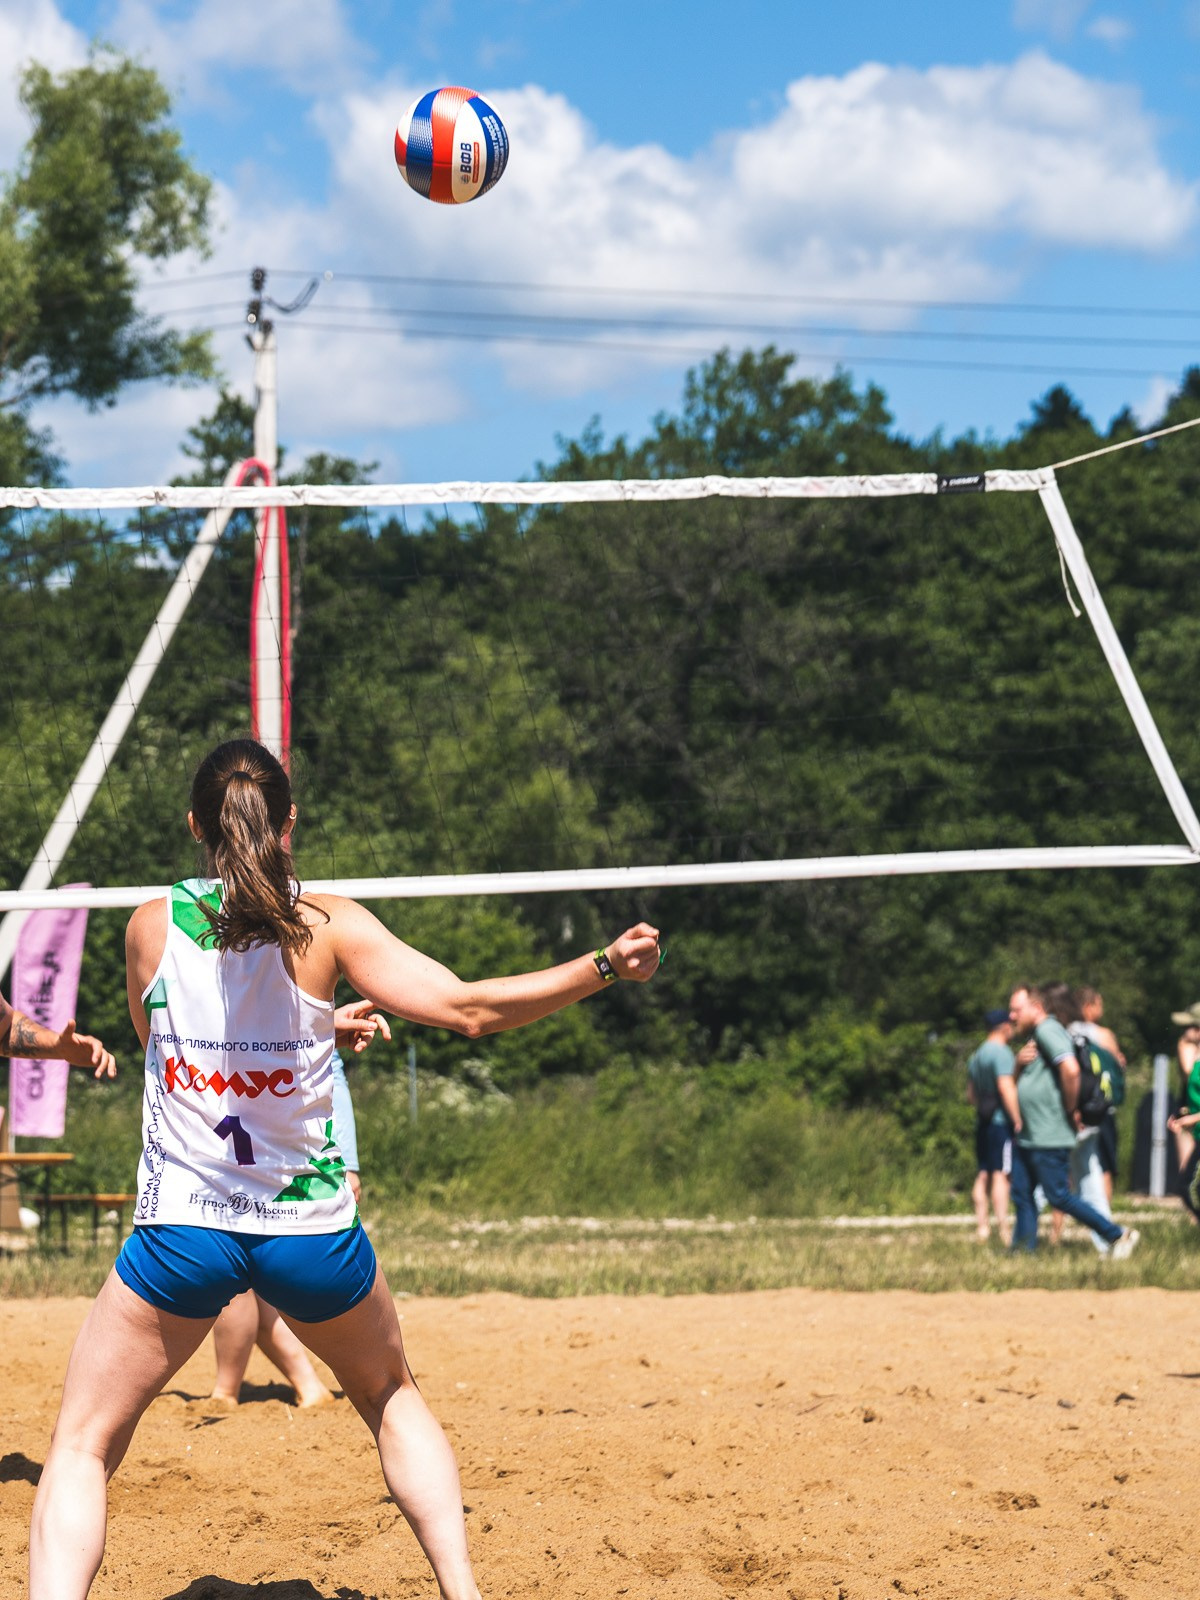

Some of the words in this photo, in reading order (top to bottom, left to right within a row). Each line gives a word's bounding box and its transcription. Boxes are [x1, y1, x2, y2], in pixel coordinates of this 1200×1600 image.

[460, 142, 472, 174] ВФВ
[185, 1038, 249, 1052] ПЛЯЖНОГО
[252, 1038, 314, 1052] ВОЛЕЙБОЛА
[213, 1115, 256, 1166] 1
[254, 1200, 298, 1216] Visconti
